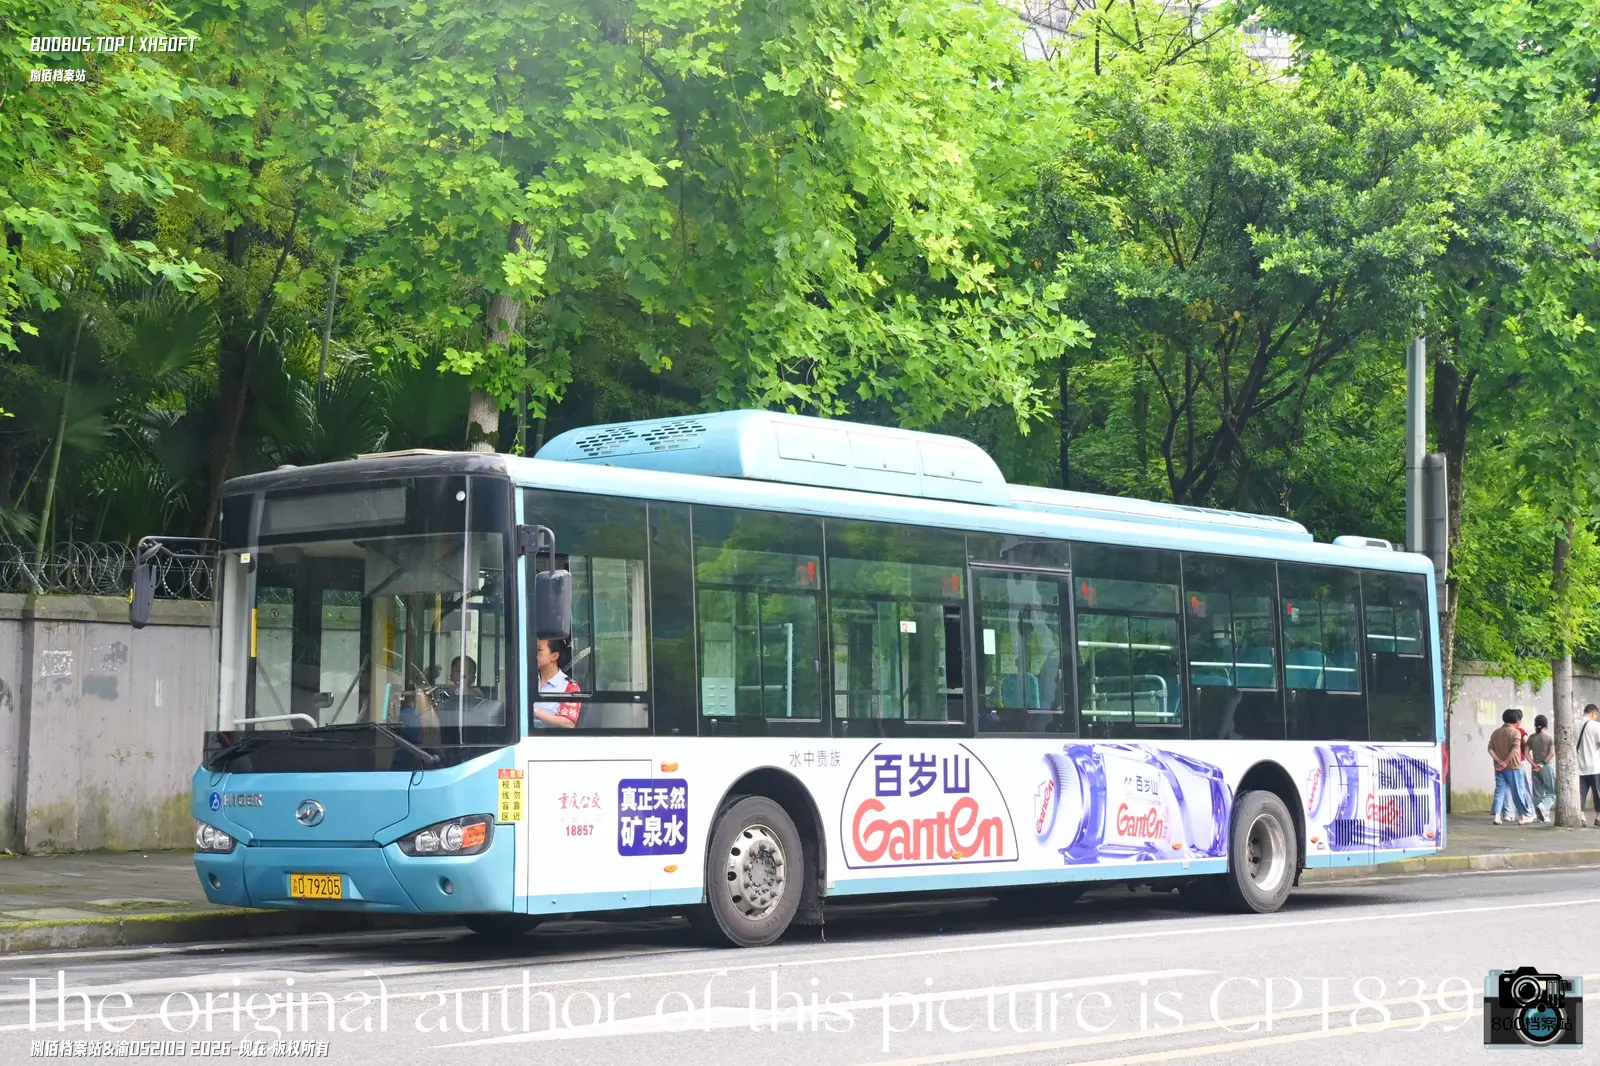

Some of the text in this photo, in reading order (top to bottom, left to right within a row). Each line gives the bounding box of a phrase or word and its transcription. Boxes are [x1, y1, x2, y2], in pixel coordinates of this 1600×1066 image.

[789, 749, 841, 768] 水中贵族
[873, 752, 970, 797] 百岁山
[1136, 775, 1158, 796] 百岁山
[223, 794, 263, 807] HIGER
[558, 792, 602, 810] 重庆公交
[620, 786, 686, 812] 真正天然
[565, 824, 594, 836] 18857
[620, 815, 685, 848] 矿泉水
[852, 797, 1004, 863] Ganten
[1117, 802, 1163, 840] Ganten
